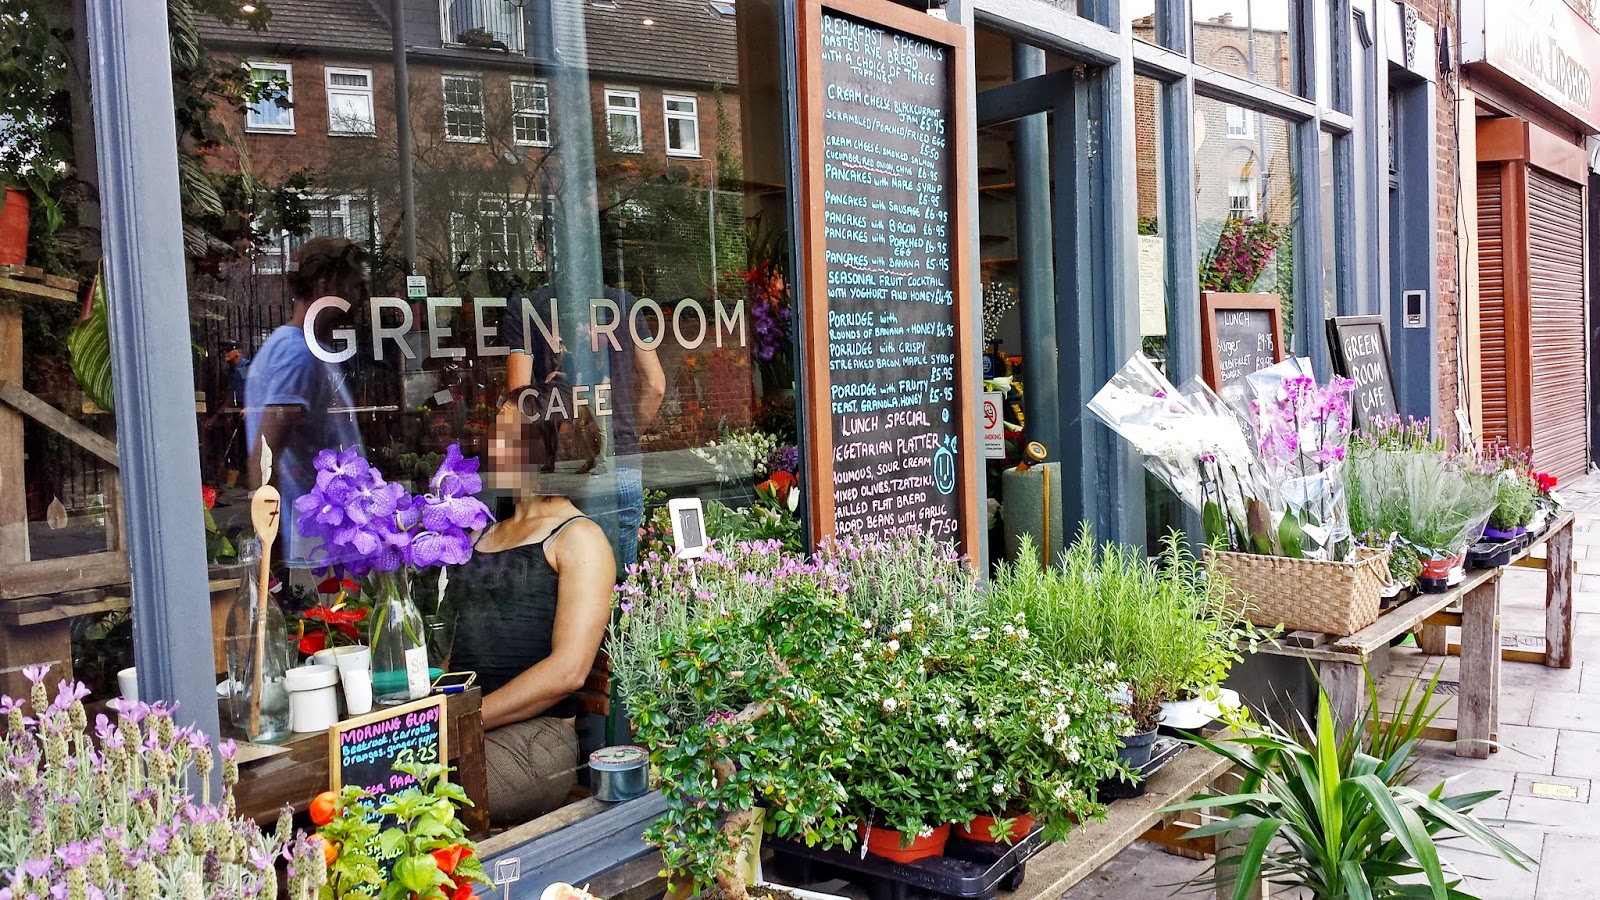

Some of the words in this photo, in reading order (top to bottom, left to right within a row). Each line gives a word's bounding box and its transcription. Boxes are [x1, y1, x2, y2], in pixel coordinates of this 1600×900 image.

[865, 44, 882, 60] RYE
[887, 50, 918, 71] BREAD
[893, 34, 943, 61] SPECIALS
[845, 53, 852, 65] A
[857, 56, 885, 73] CHOICE
[889, 65, 901, 78] OF
[904, 68, 935, 86] THREE
[850, 66, 893, 85] TOPPINGS
[827, 84, 861, 103] CREAM
[864, 94, 893, 112] CHEESE,
[899, 113, 918, 125] JAM
[920, 116, 945, 134] £5.95
[826, 135, 852, 148] CREAM
[882, 148, 908, 161] SMOKED
[911, 155, 935, 169] SALMON
[932, 135, 946, 148] EGG
[824, 163, 872, 185] PANCAKES
[873, 176, 889, 187] with
[916, 182, 943, 194] SYRUP
[918, 167, 939, 182] £6.95
[824, 190, 868, 208] PANCAKES
[871, 200, 886, 211] with
[889, 200, 921, 218] SAUSAGE
[924, 206, 948, 223] £6.95
[918, 193, 940, 208] £5.95
[824, 210, 867, 229] PANCAKES
[870, 220, 885, 231] with
[888, 219, 917, 234] BACON
[923, 223, 945, 238] £6.95
[824, 226, 868, 244] PANCAKES
[871, 233, 886, 245] with
[888, 235, 924, 249] POACHED
[924, 240, 948, 255] £6.95
[894, 248, 912, 257] EGG
[825, 250, 868, 267] PANCAKES
[871, 256, 886, 267] with
[889, 257, 920, 269] BANANA
[925, 258, 950, 271] £5.95
[828, 271, 876, 286] SEASONAL
[879, 274, 904, 287] FRUIT
[907, 275, 944, 287] COCKTAIL
[828, 288, 847, 299] WITH
[850, 287, 888, 300] YOGHURT
[891, 289, 908, 301] AND
[910, 291, 935, 303] HONEY
[303, 296, 561, 364] GREEN
[590, 297, 747, 354] ROOM
[828, 310, 874, 328] PORRIDGE
[880, 312, 898, 324] with
[829, 328, 861, 341] ROUNDS
[863, 328, 873, 339] OF
[874, 326, 904, 336] BANANA
[911, 321, 936, 335] HONEY
[1224, 312, 1250, 327] LUNCH
[829, 341, 873, 357] PORRIDGE
[880, 342, 896, 353] with
[898, 341, 926, 355] CRISPY
[1344, 333, 1380, 361] GREEN
[829, 358, 874, 370] STREAKED
[902, 356, 928, 366] MAPLE
[930, 367, 953, 383] £5.95
[1352, 362, 1384, 390] ROOM
[517, 383, 613, 423] CAFE
[831, 382, 877, 400] PORRIDGE
[880, 383, 896, 395] with
[898, 379, 929, 393] FRUITY
[929, 387, 953, 404] £5.95
[900, 391, 923, 406] HONEY
[1361, 386, 1386, 413] CAFE
[842, 415, 879, 437] LUNCH
[884, 411, 931, 430] SPECIAL
[832, 440, 893, 464] VEGETARIAN
[896, 433, 941, 456] PLATTER
[876, 460, 900, 476] SOUR
[902, 456, 931, 469] CREAM
[833, 486, 858, 503] MIXED
[872, 497, 893, 512] FLAT
[896, 492, 926, 508] BREAD
[264, 499, 279, 527] 7
[834, 519, 863, 536] BROAD
[866, 512, 894, 529] BEANS
[897, 509, 916, 523] WITH
[918, 503, 947, 519] GARLIC
[340, 717, 402, 746] MORNING
[406, 706, 439, 728] GLORY
